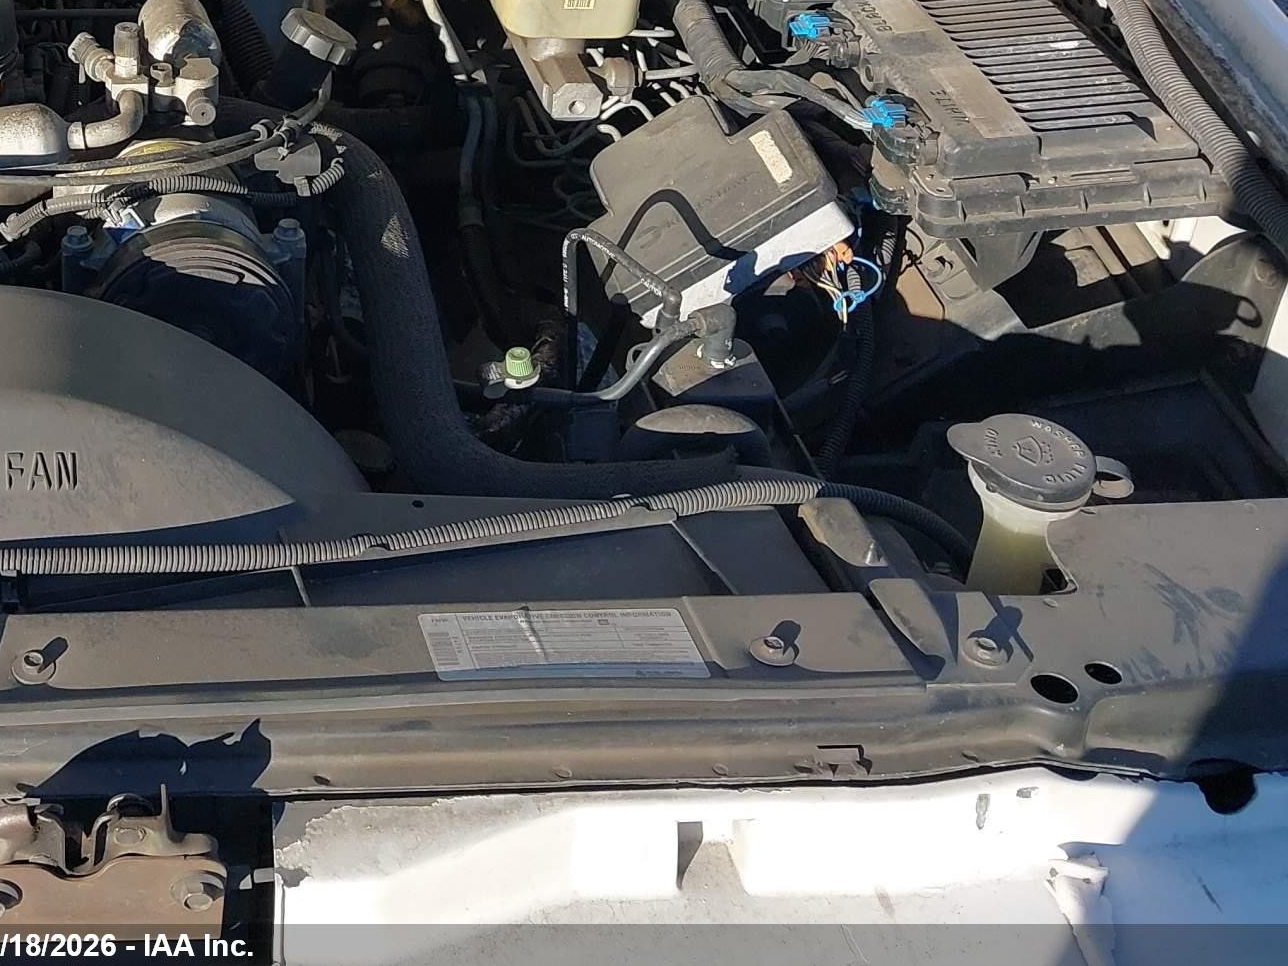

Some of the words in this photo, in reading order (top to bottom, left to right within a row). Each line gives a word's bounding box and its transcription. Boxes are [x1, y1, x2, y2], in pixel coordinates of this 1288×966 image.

[855, 1, 893, 31] BLACK
[929, 90, 970, 124] WHITE
[1031, 418, 1087, 459] WASHER
[4, 450, 80, 492] FAN
[1044, 462, 1088, 483] FLUID
